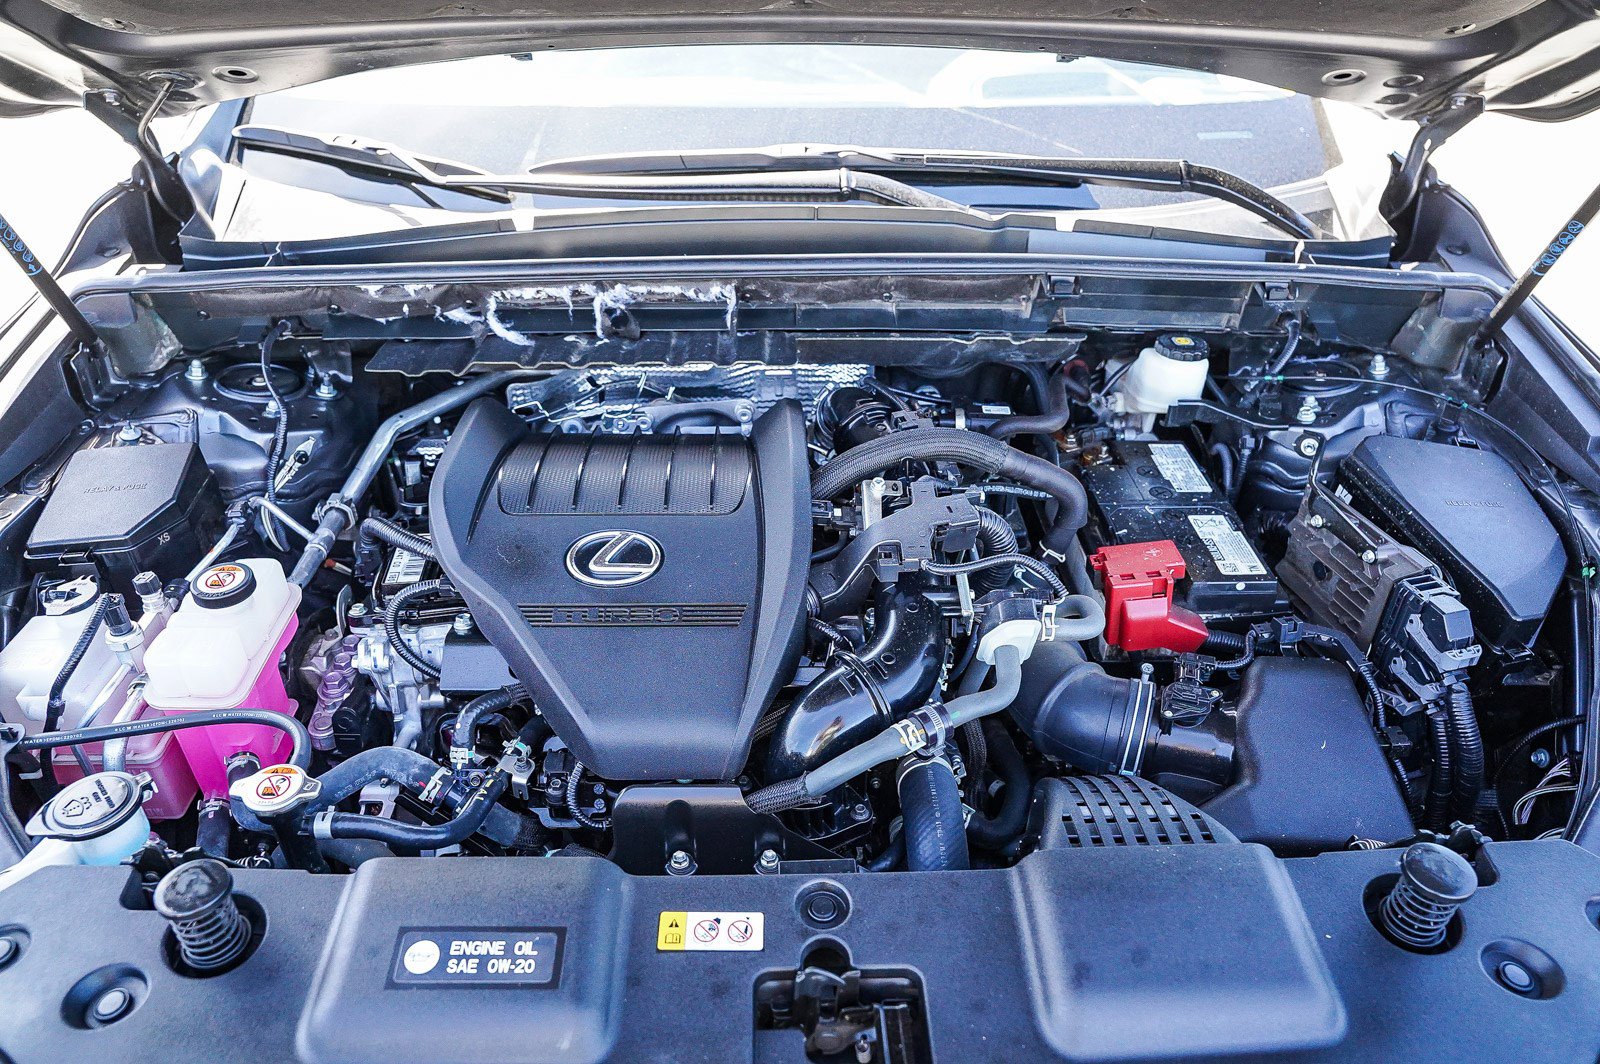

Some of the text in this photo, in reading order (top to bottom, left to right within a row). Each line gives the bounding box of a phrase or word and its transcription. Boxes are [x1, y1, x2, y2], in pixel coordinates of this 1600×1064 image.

[158, 532, 171, 546] XS
[557, 607, 681, 623] TURBO
[449, 940, 539, 956] ENGINE OIL
[446, 958, 536, 974] SAE 0W-20
